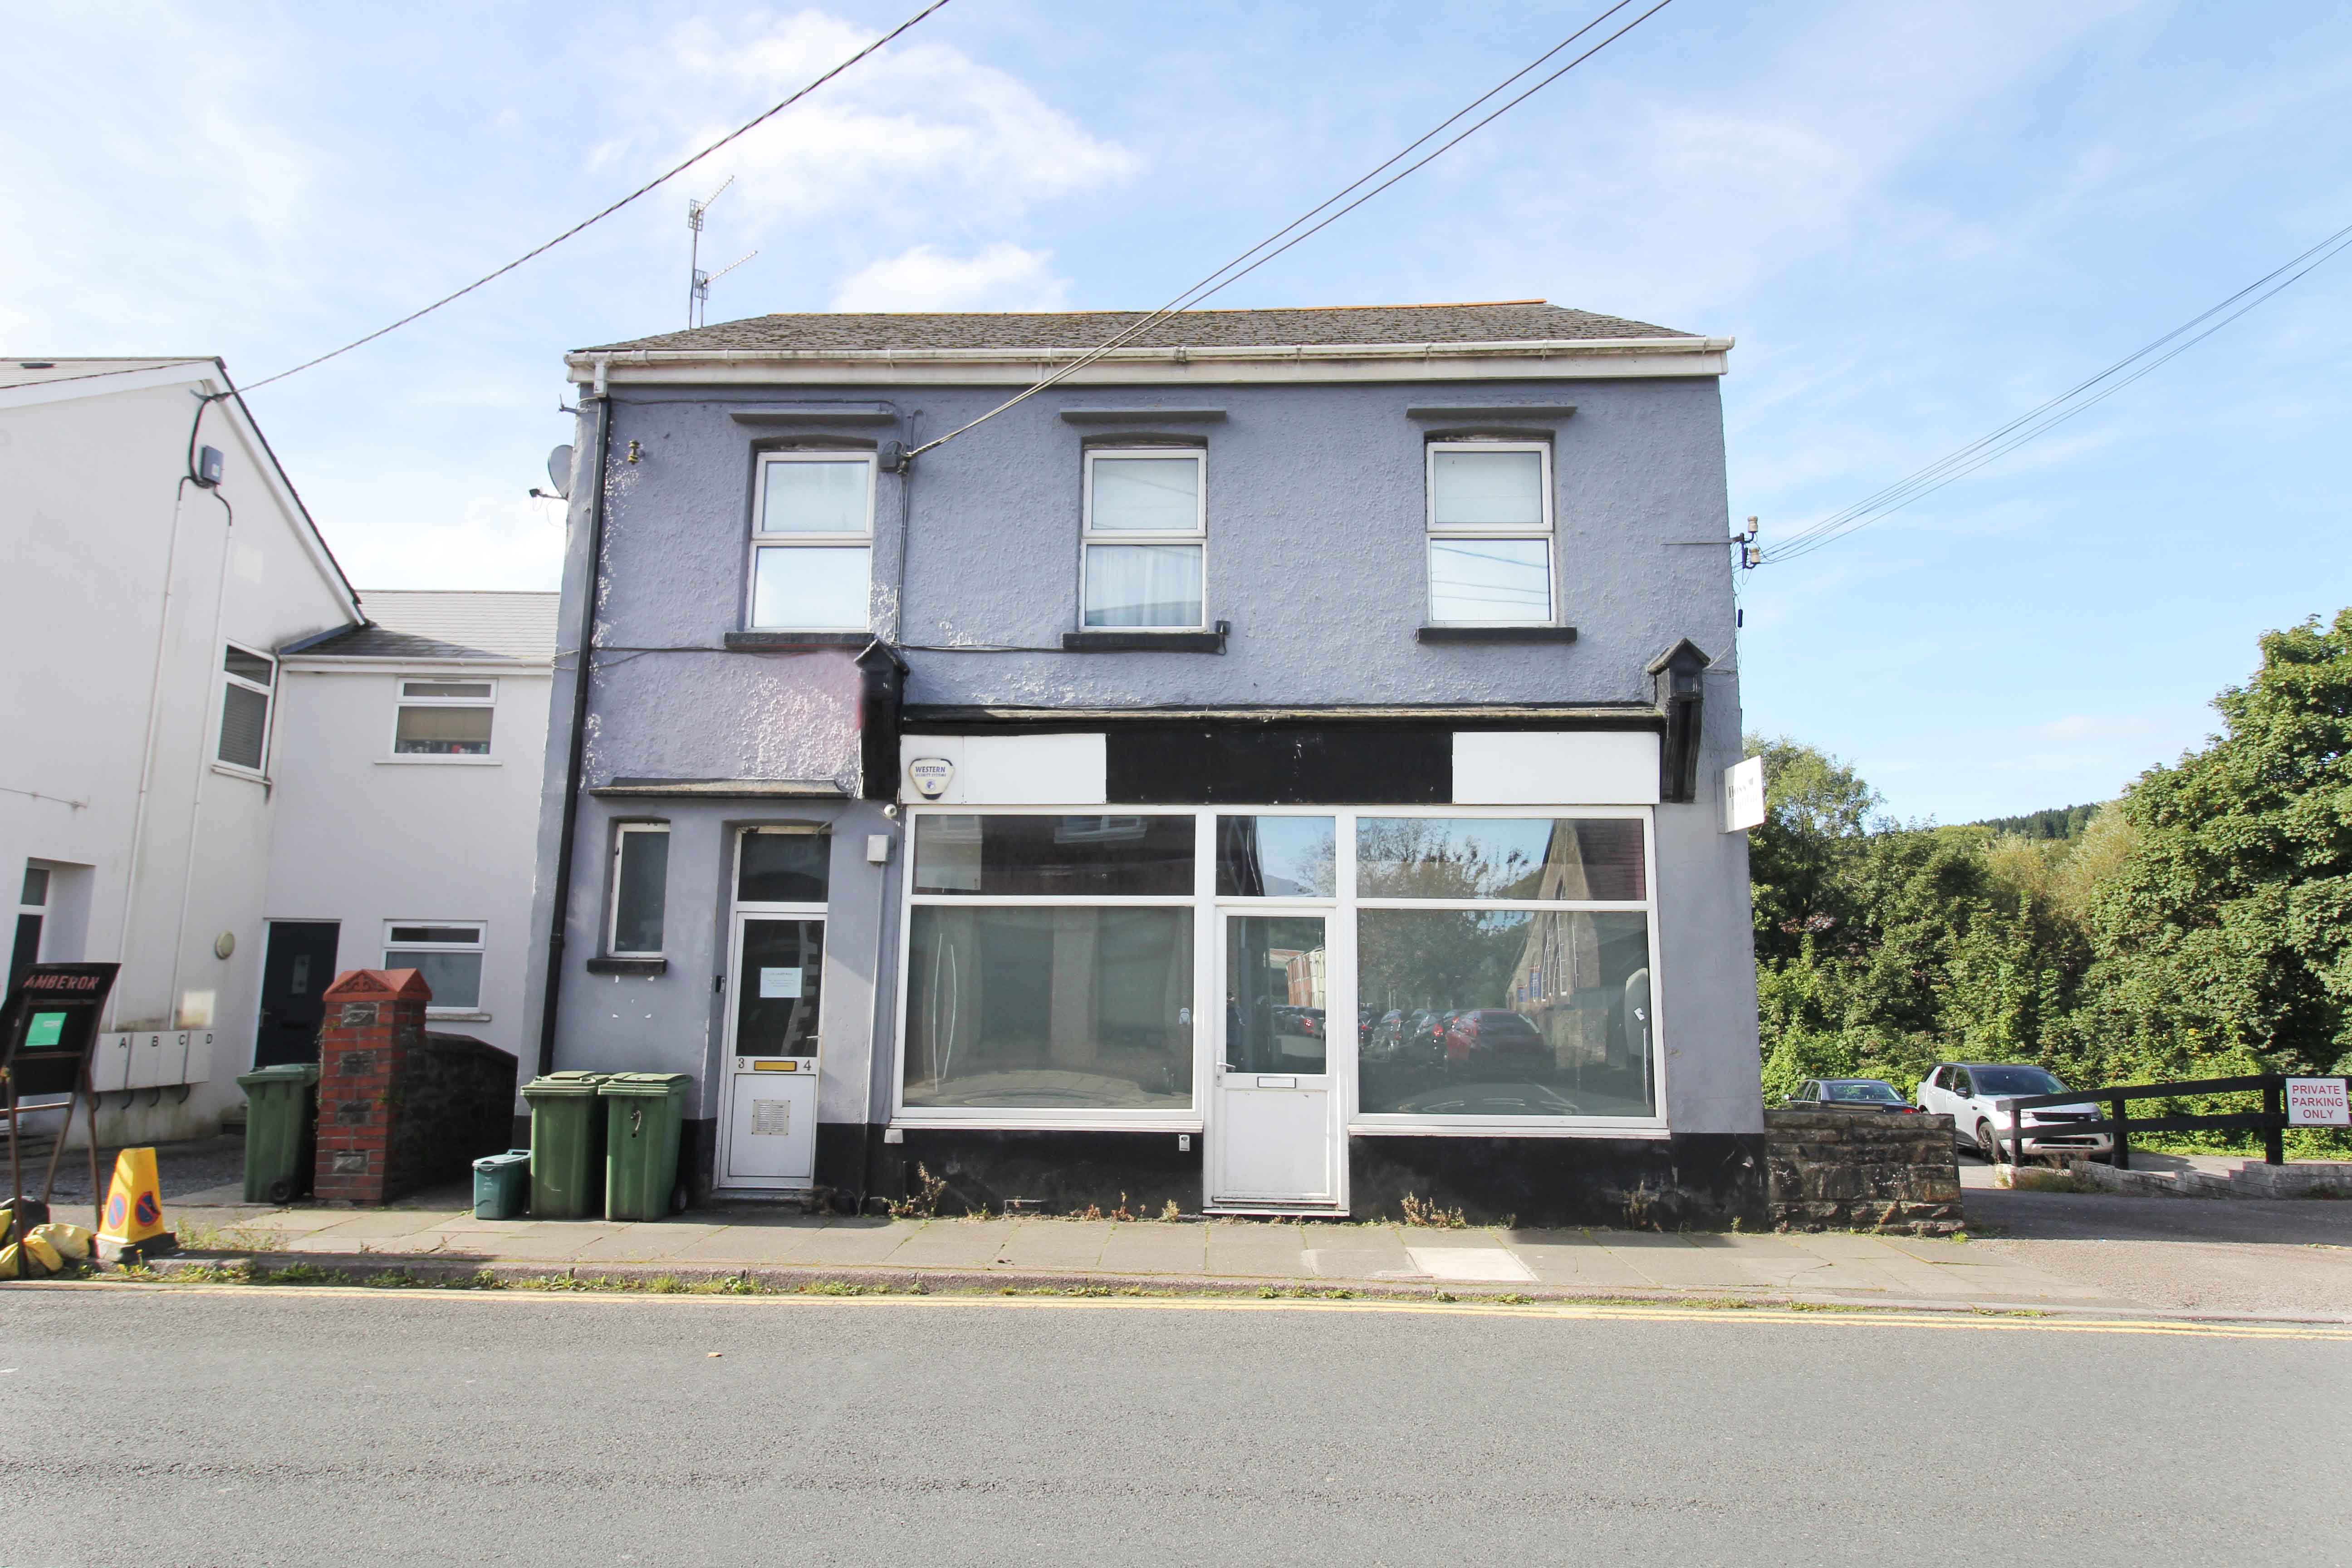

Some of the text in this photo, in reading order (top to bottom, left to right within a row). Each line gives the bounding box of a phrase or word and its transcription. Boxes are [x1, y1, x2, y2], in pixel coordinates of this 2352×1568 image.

[119, 1037, 127, 1048] A
[152, 1036, 158, 1047] B
[179, 1034, 185, 1045] C
[206, 1034, 213, 1044] D
[738, 1058, 745, 1068] 3
[804, 1060, 811, 1071] 4
[2292, 1085, 2341, 1094] PRIVATE
[2292, 1098, 2343, 1107] PARKING
[2303, 1109, 2333, 1118] ONLY
